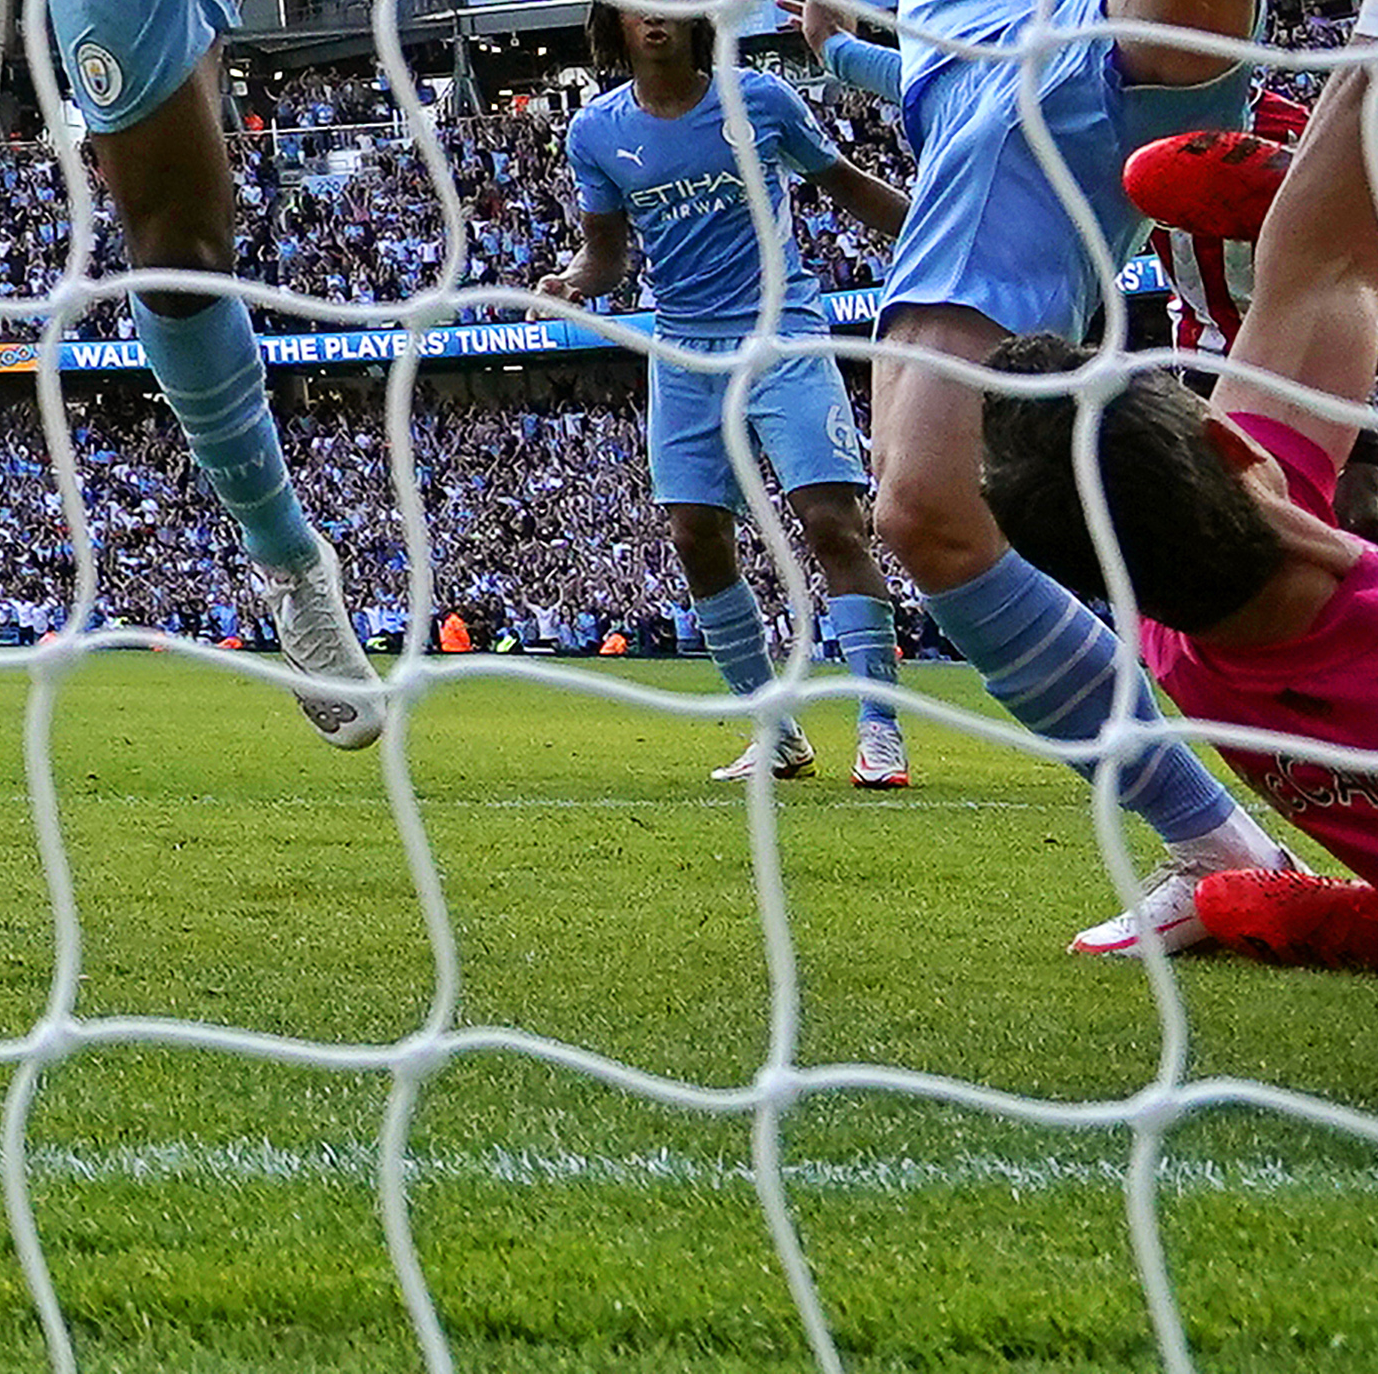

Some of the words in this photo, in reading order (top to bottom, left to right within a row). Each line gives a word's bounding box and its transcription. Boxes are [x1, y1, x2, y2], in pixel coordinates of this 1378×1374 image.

[630, 170, 746, 208] ETIHA
[263, 338, 319, 364] THE
[455, 326, 558, 354] TUNNEL
